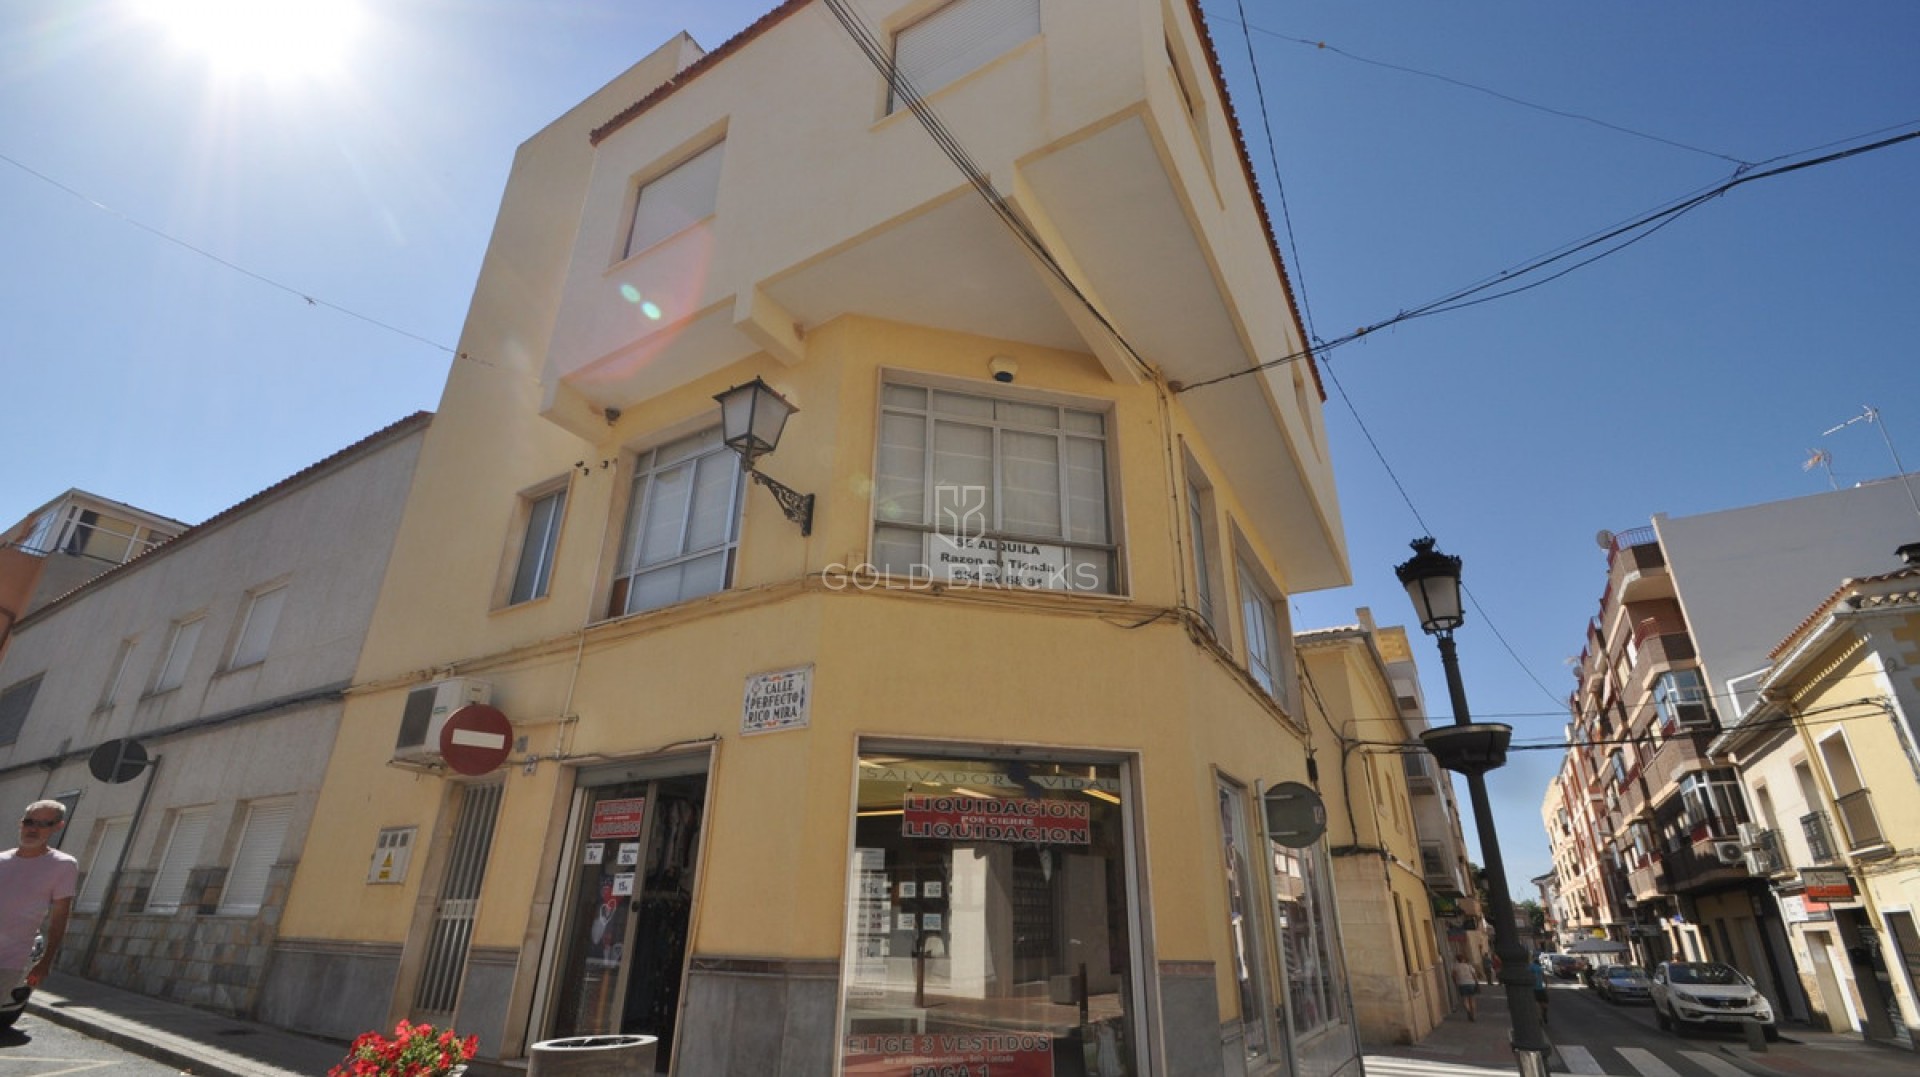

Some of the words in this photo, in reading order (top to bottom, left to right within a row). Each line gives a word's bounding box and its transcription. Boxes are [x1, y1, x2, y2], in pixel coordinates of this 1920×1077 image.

[957, 537, 973, 548] SE
[979, 540, 1040, 555] ALQUILA
[940, 552, 983, 565] Razon
[765, 679, 794, 694] CALLE
[750, 692, 799, 709] PERFECTO
[748, 709, 770, 723] RICO
[773, 705, 797, 720] MIRA
[866, 767, 1005, 787] SALVADOR
[1043, 775, 1120, 791] VIDAL
[906, 795, 1088, 818] LIQUIDACION
[961, 815, 985, 824] POR
[989, 817, 1034, 826] CIERRE
[905, 822, 1088, 842] LIQUIDACION
[847, 1036, 914, 1054] ELIGE
[922, 1035, 935, 1051] 3
[941, 1034, 1050, 1052] VESTIDOS
[911, 1064, 970, 1077] PAGA
